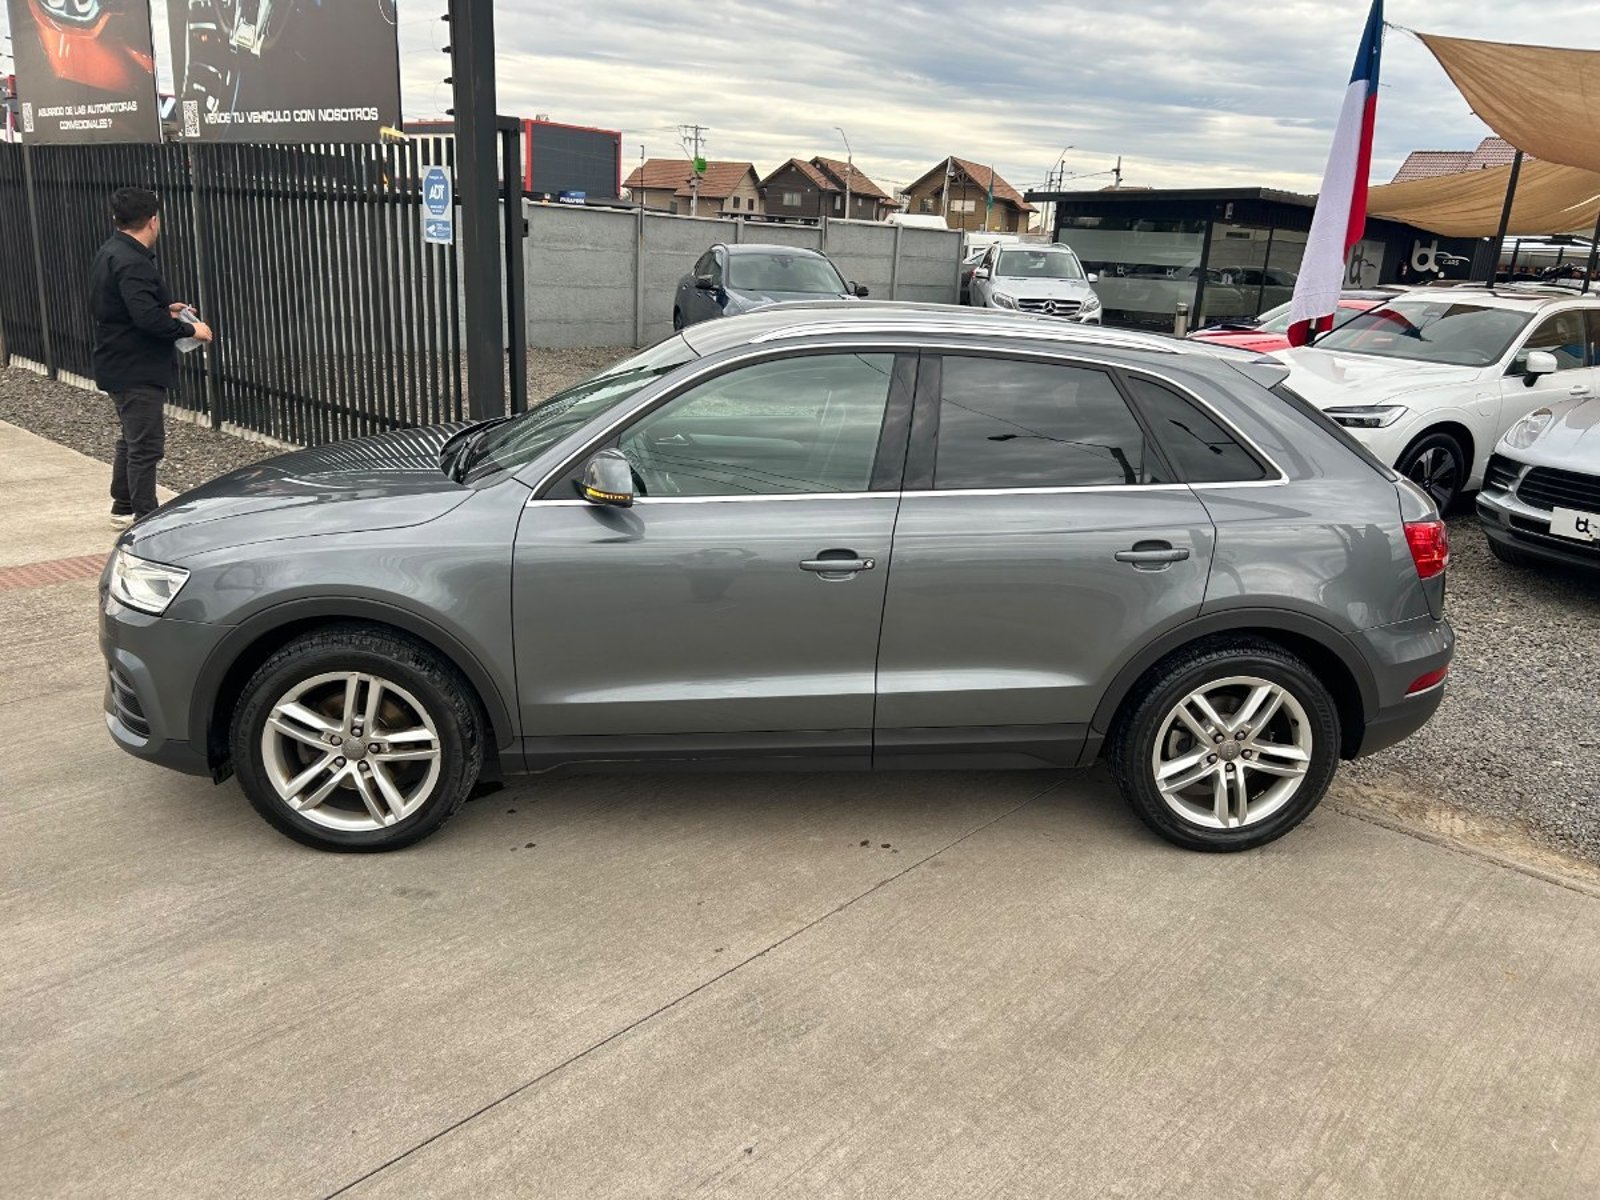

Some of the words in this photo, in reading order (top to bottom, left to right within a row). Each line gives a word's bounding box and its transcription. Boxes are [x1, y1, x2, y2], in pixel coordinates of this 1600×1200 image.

[65, 106, 73, 115] DE
[74, 104, 86, 115] LAS
[87, 101, 137, 114] AUTOMOTORAS
[204, 111, 231, 124] VENDE
[232, 111, 245, 124] TU
[247, 110, 291, 124] VEHICULO
[293, 109, 315, 122] CON
[318, 107, 379, 122] NOSOTROS
[429, 184, 445, 200] ADT
